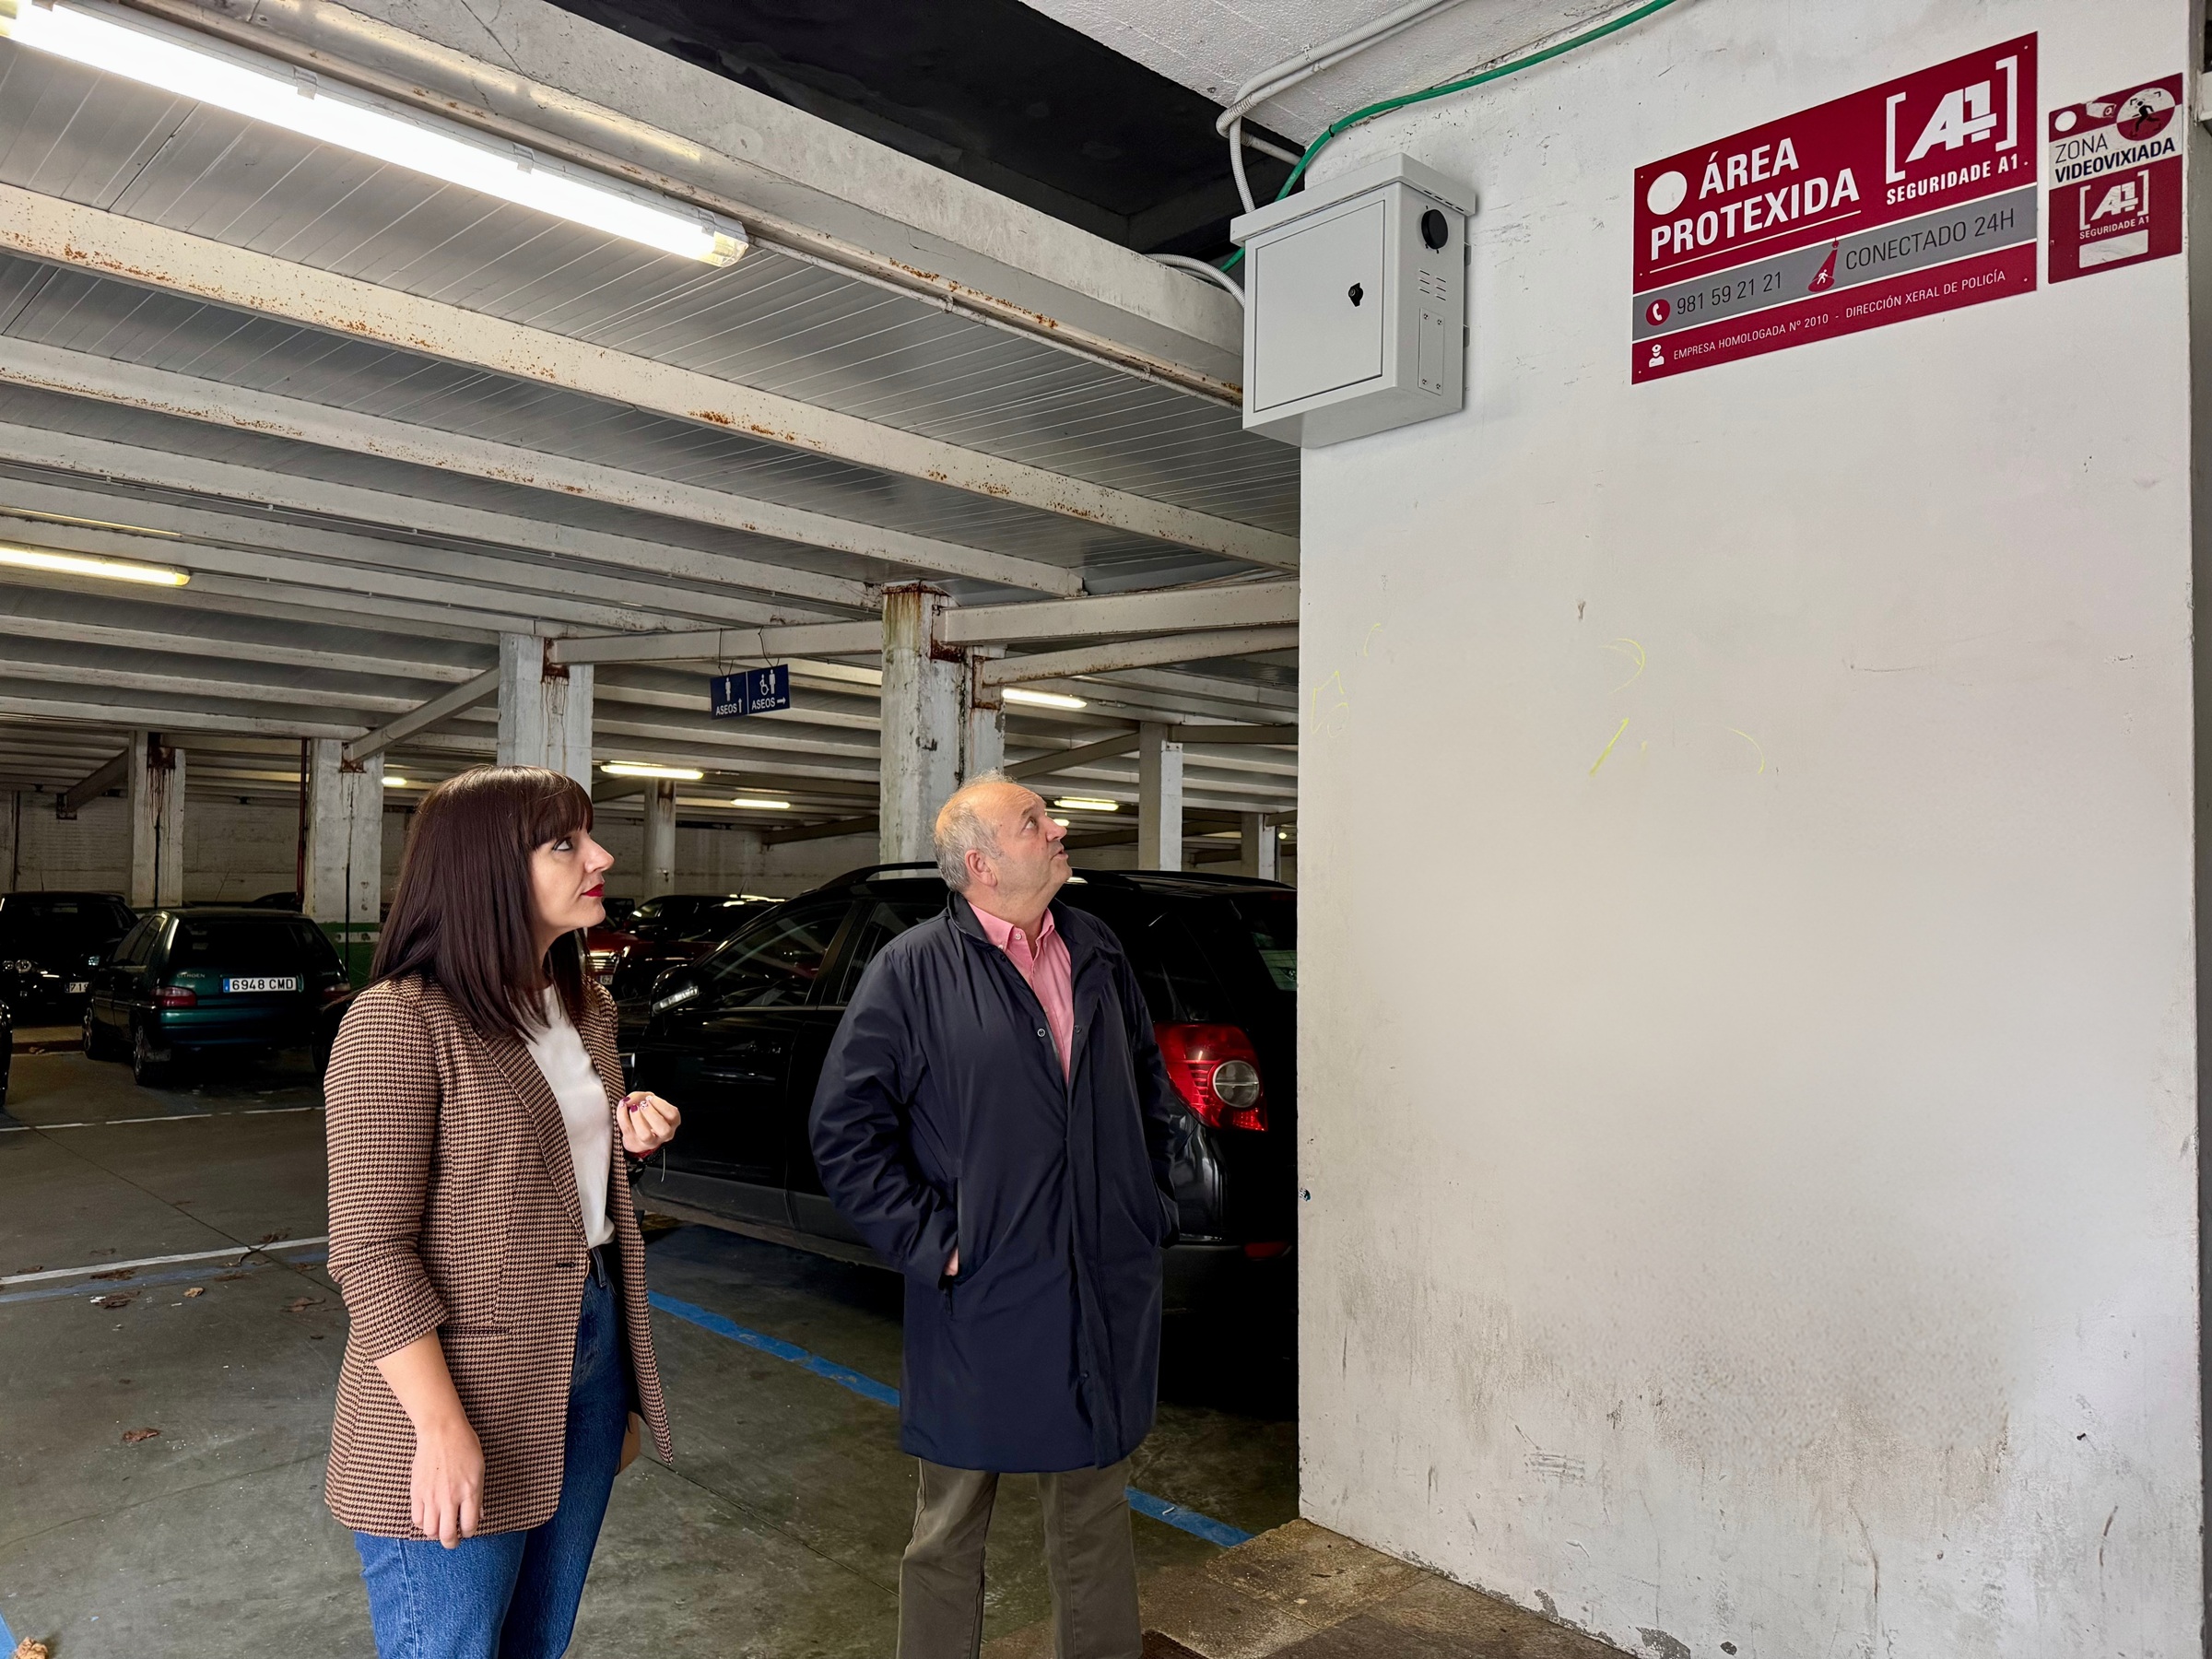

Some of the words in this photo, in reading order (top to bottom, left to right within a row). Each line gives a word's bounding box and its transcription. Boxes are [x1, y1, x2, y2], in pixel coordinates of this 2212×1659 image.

[1699, 137, 1799, 200] ÁREA
[2055, 133, 2108, 164] ZONA
[2055, 137, 2175, 183] VIDEOVIXIADA
[1887, 160, 1991, 206] SEGURIDADE
[1651, 168, 1860, 261] PROTEXIDA
[2079, 219, 2136, 240] SEGURIDADE
[2138, 216, 2149, 225] A1
[1846, 221, 1966, 270] CONECTADO
[1974, 207, 2014, 237] 24H
[1674, 341, 1716, 360] EMPRESA
[1718, 324, 1786, 348] HOMOLOGADA
[1805, 313, 1829, 328] 2010
[1846, 292, 1901, 318] DIRECCIÓN
[1905, 287, 1940, 304] XERAL
[1943, 282, 1958, 295] DE
[1961, 269, 2006, 291] POLICÍA
[1677, 292, 1703, 315] 981
[1712, 285, 1731, 306] 59
[1737, 278, 1754, 300] 21
[1763, 271, 1781, 293] 21
[715, 703, 737, 716] ASEOS
[751, 697, 775, 711] ASEOS
[232, 979, 265, 990] 6948
[269, 978, 294, 990] CMD
